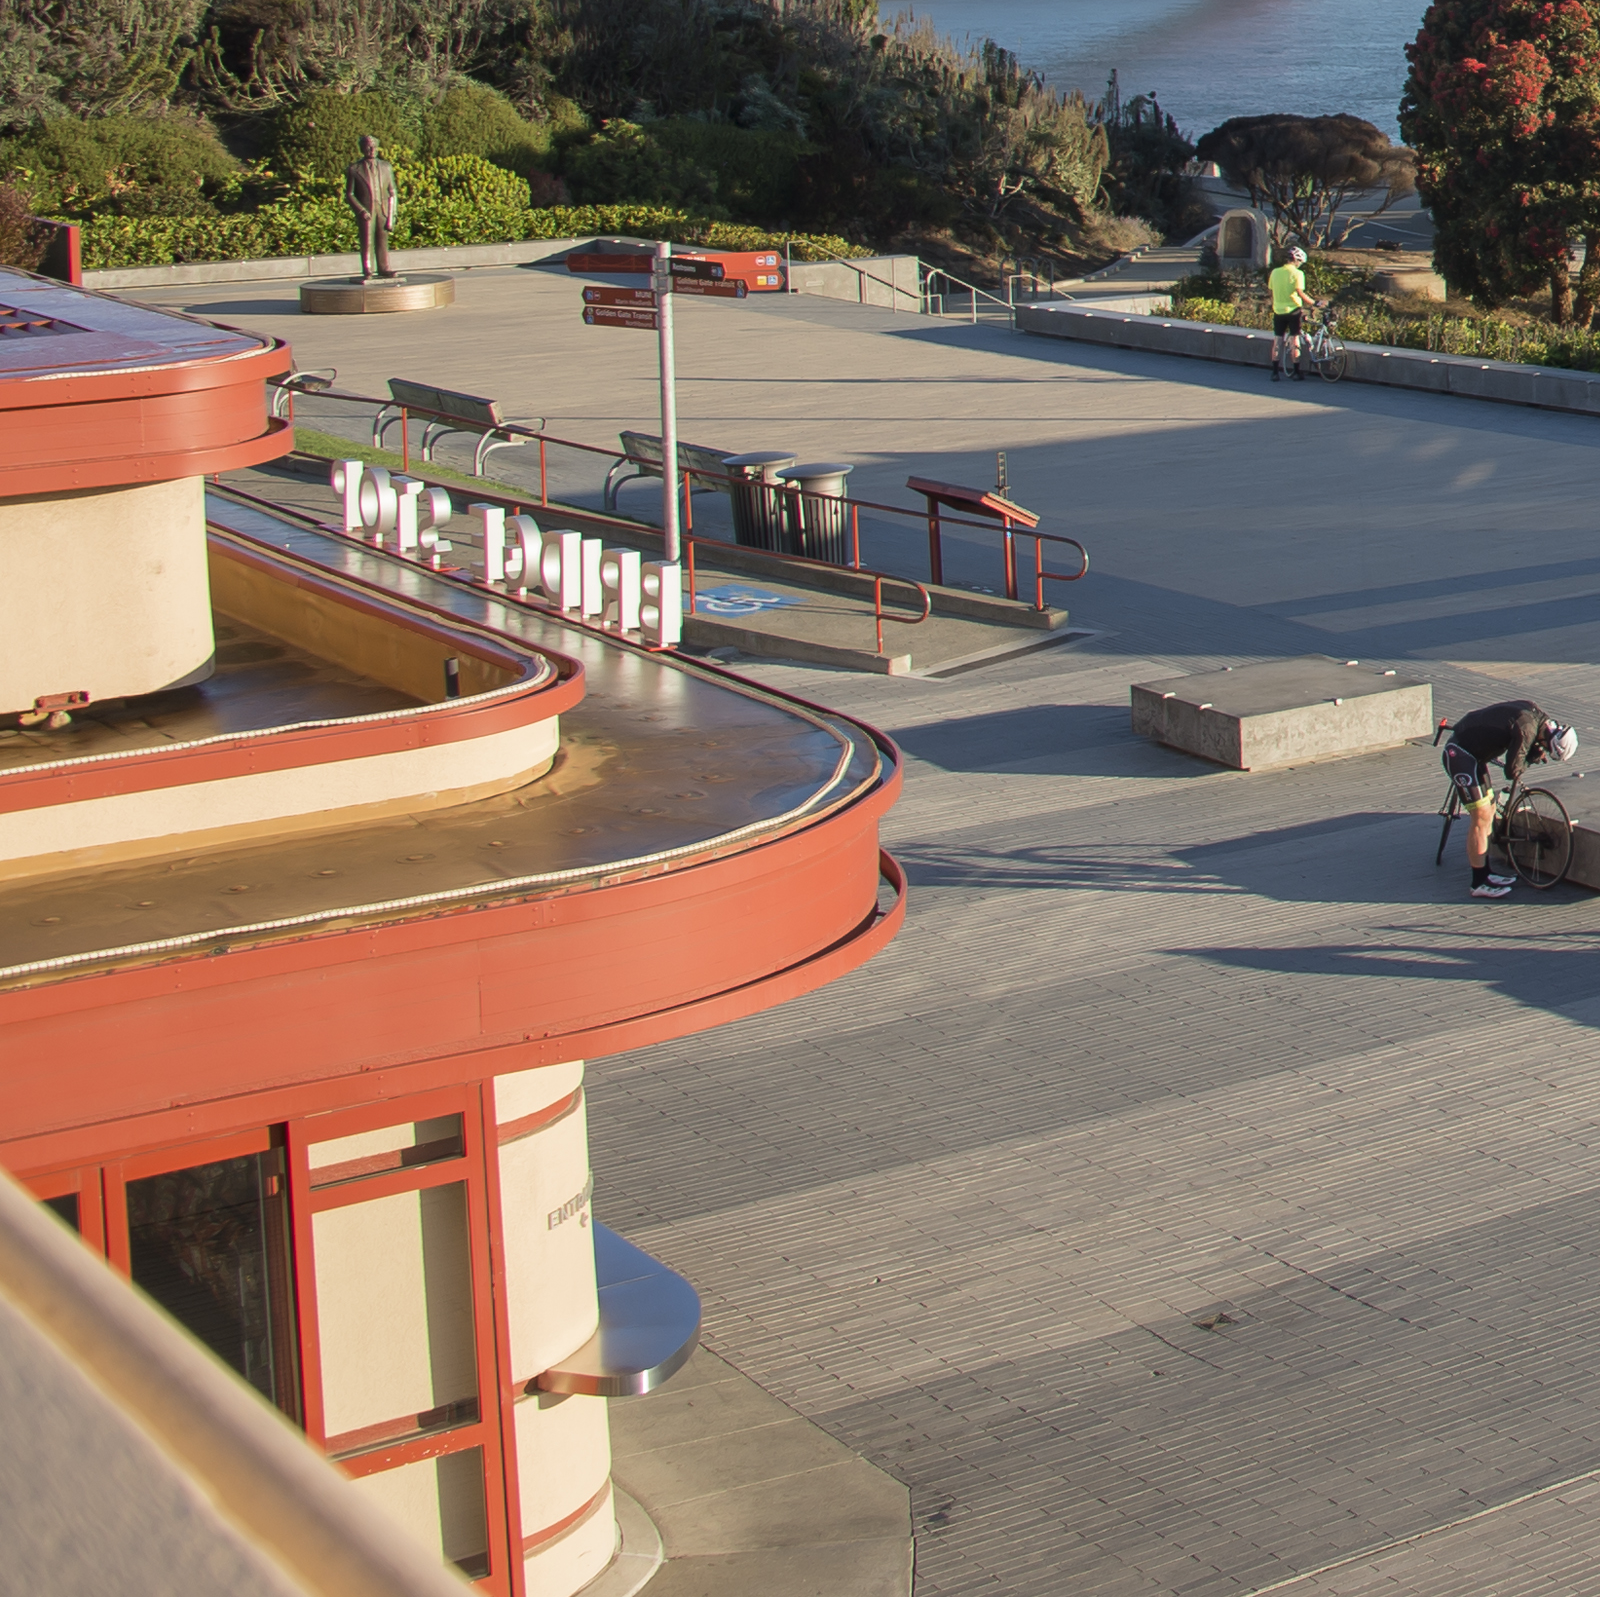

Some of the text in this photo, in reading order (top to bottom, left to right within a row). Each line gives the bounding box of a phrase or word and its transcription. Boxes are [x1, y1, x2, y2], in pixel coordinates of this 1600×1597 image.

[676, 276, 698, 286] Golden
[699, 278, 714, 287] Gate
[595, 308, 652, 320] Golden Gate Transit
